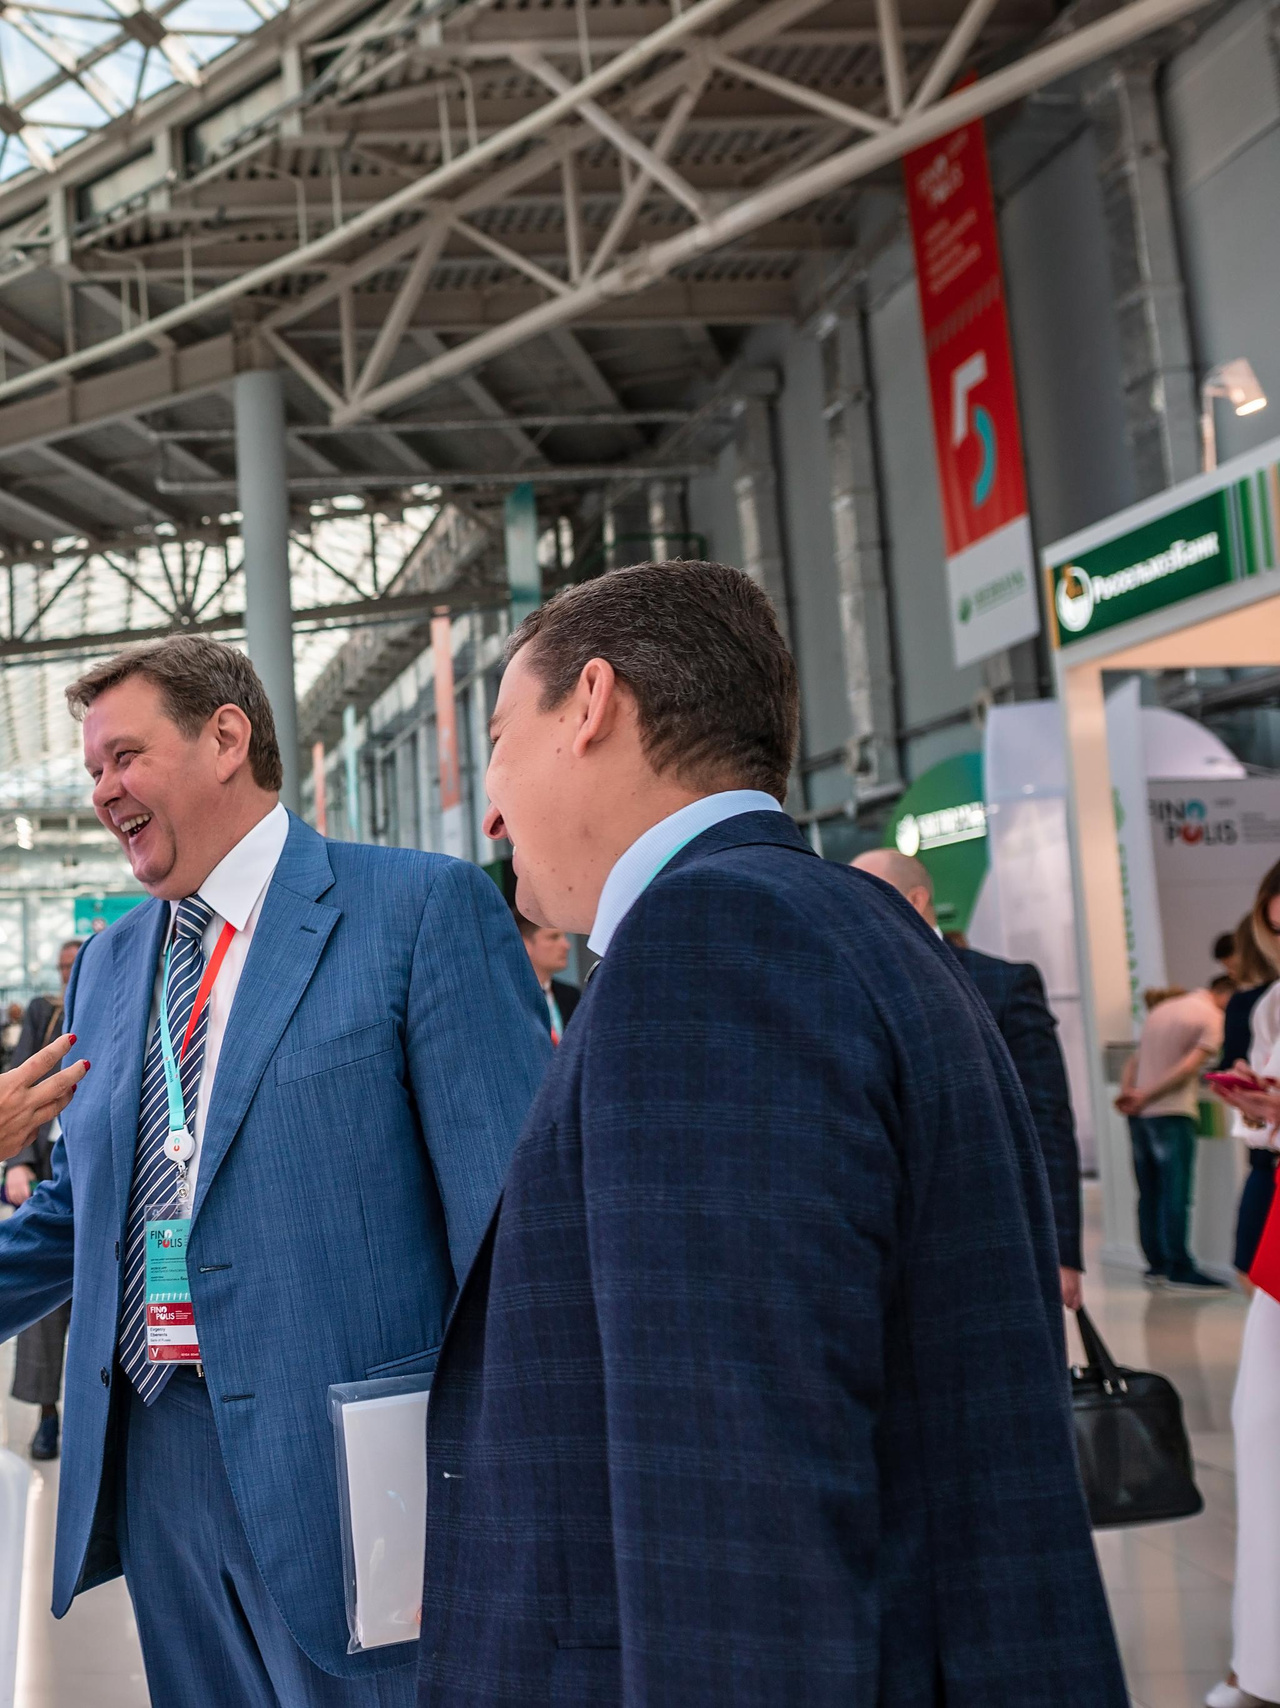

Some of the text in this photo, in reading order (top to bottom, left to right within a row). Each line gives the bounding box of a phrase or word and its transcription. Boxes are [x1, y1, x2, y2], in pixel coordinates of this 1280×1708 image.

[150, 1229, 173, 1240] FINO
[157, 1238, 183, 1249] POLIS
[150, 1306, 167, 1314] FINO
[156, 1312, 175, 1320] POLIS
